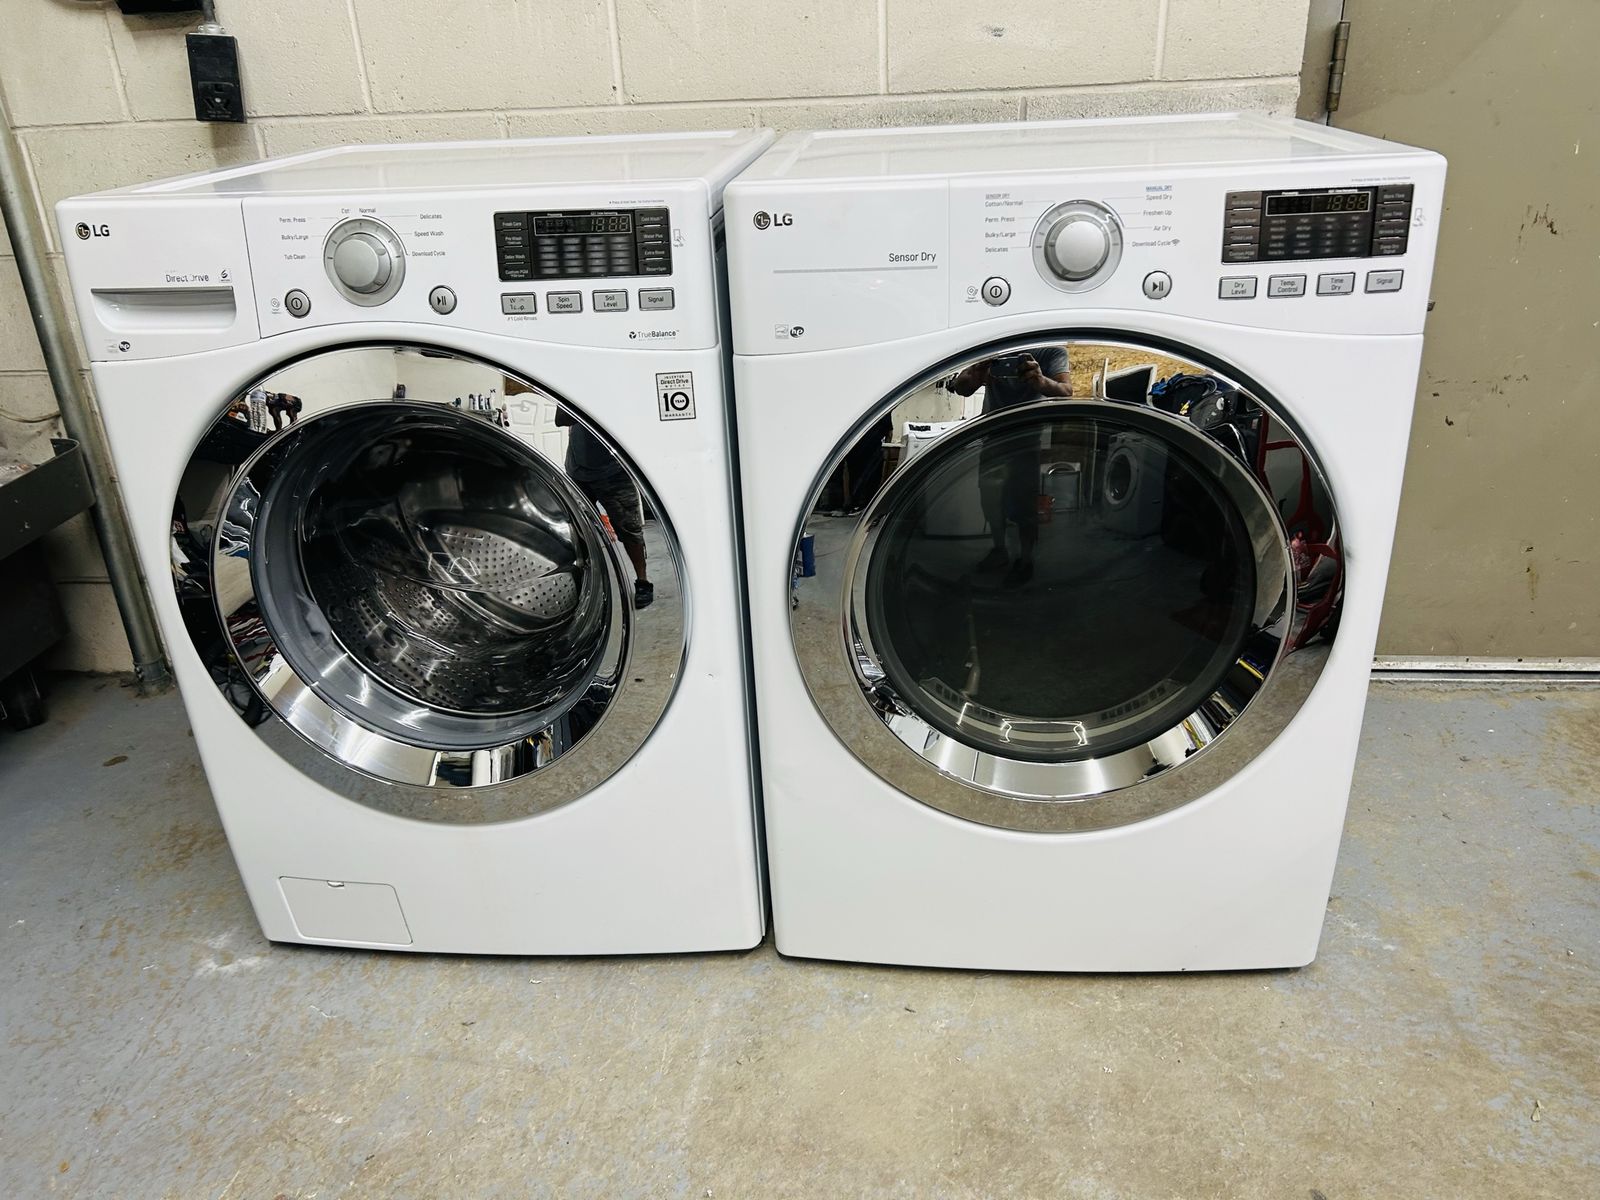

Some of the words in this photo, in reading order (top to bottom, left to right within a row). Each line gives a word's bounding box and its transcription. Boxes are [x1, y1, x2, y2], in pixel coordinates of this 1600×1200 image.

[773, 213, 793, 227] LG
[92, 224, 110, 237] LG
[888, 253, 919, 262] Sensor
[921, 251, 937, 263] Dry
[1234, 281, 1244, 289] Dry
[1331, 284, 1341, 292] Dry
[648, 296, 664, 304] Signal
[556, 302, 573, 310] Speed
[663, 391, 690, 412] 10
